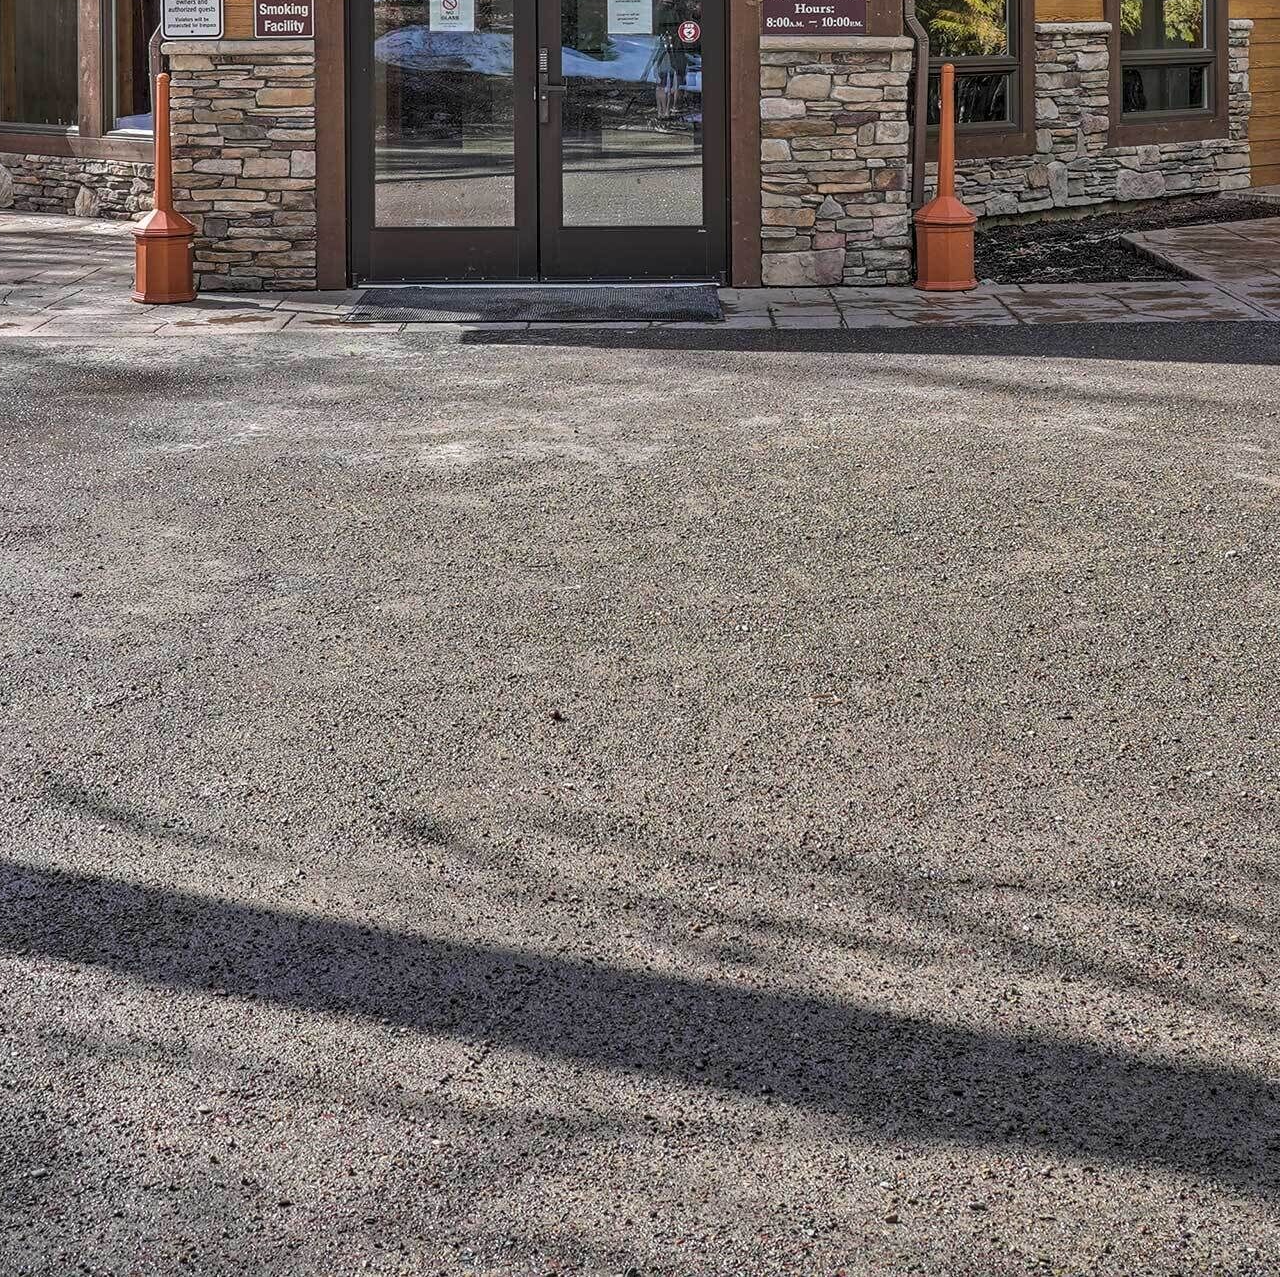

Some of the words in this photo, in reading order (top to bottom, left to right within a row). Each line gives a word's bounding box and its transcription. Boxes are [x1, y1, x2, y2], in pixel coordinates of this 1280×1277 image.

[198, 6, 216, 14] guests
[259, 3, 309, 17] Smoking
[794, 3, 835, 14] Hours:
[264, 20, 305, 33] Facility
